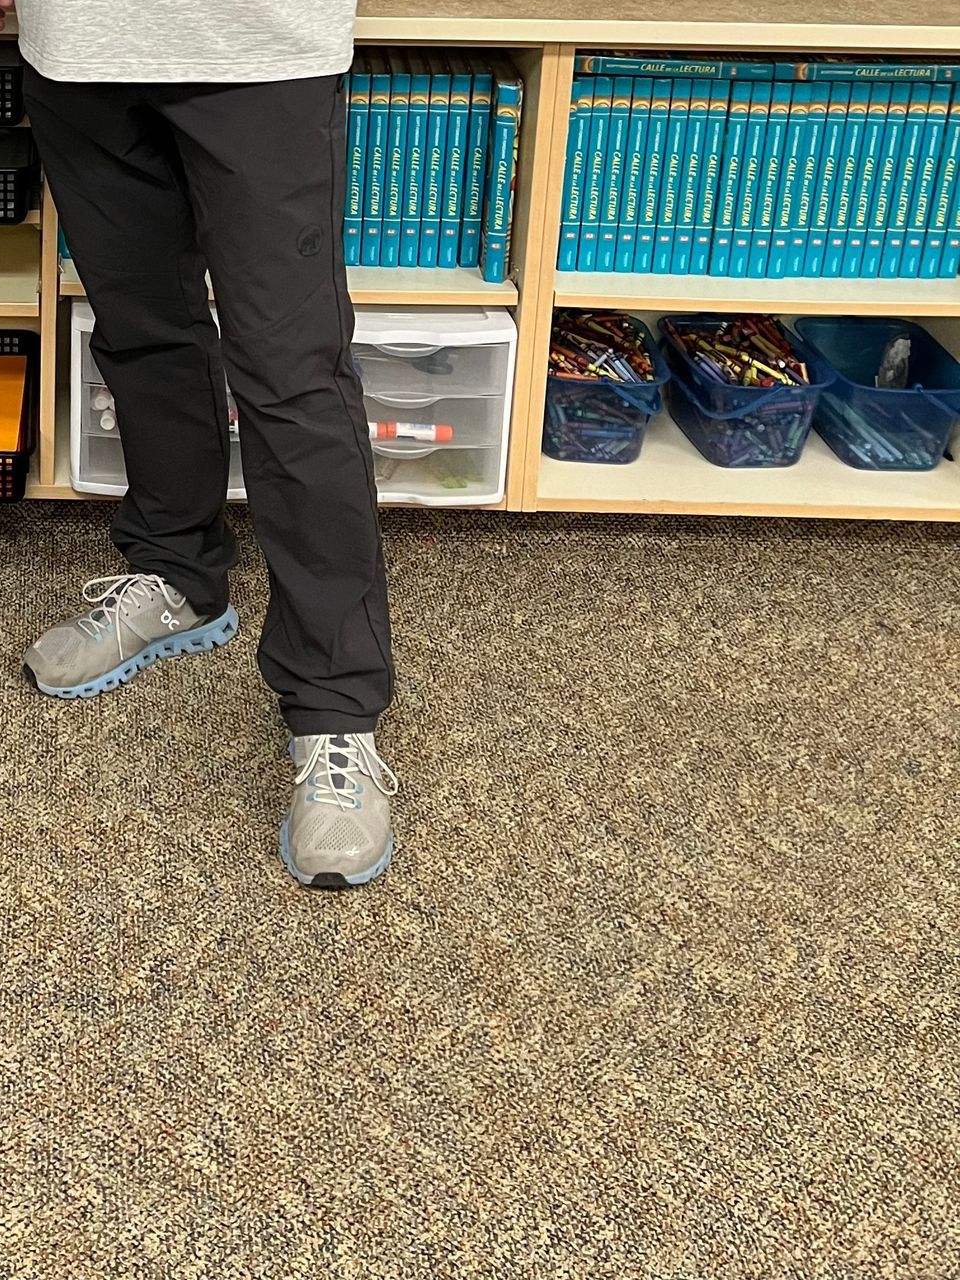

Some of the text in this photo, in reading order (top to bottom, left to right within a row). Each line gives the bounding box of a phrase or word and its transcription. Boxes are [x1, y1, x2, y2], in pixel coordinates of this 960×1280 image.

[640, 62, 666, 72] CALLE
[680, 64, 716, 74] LECTURA
[855, 68, 880, 77] CALLE
[894, 68, 931, 78] LECTURA
